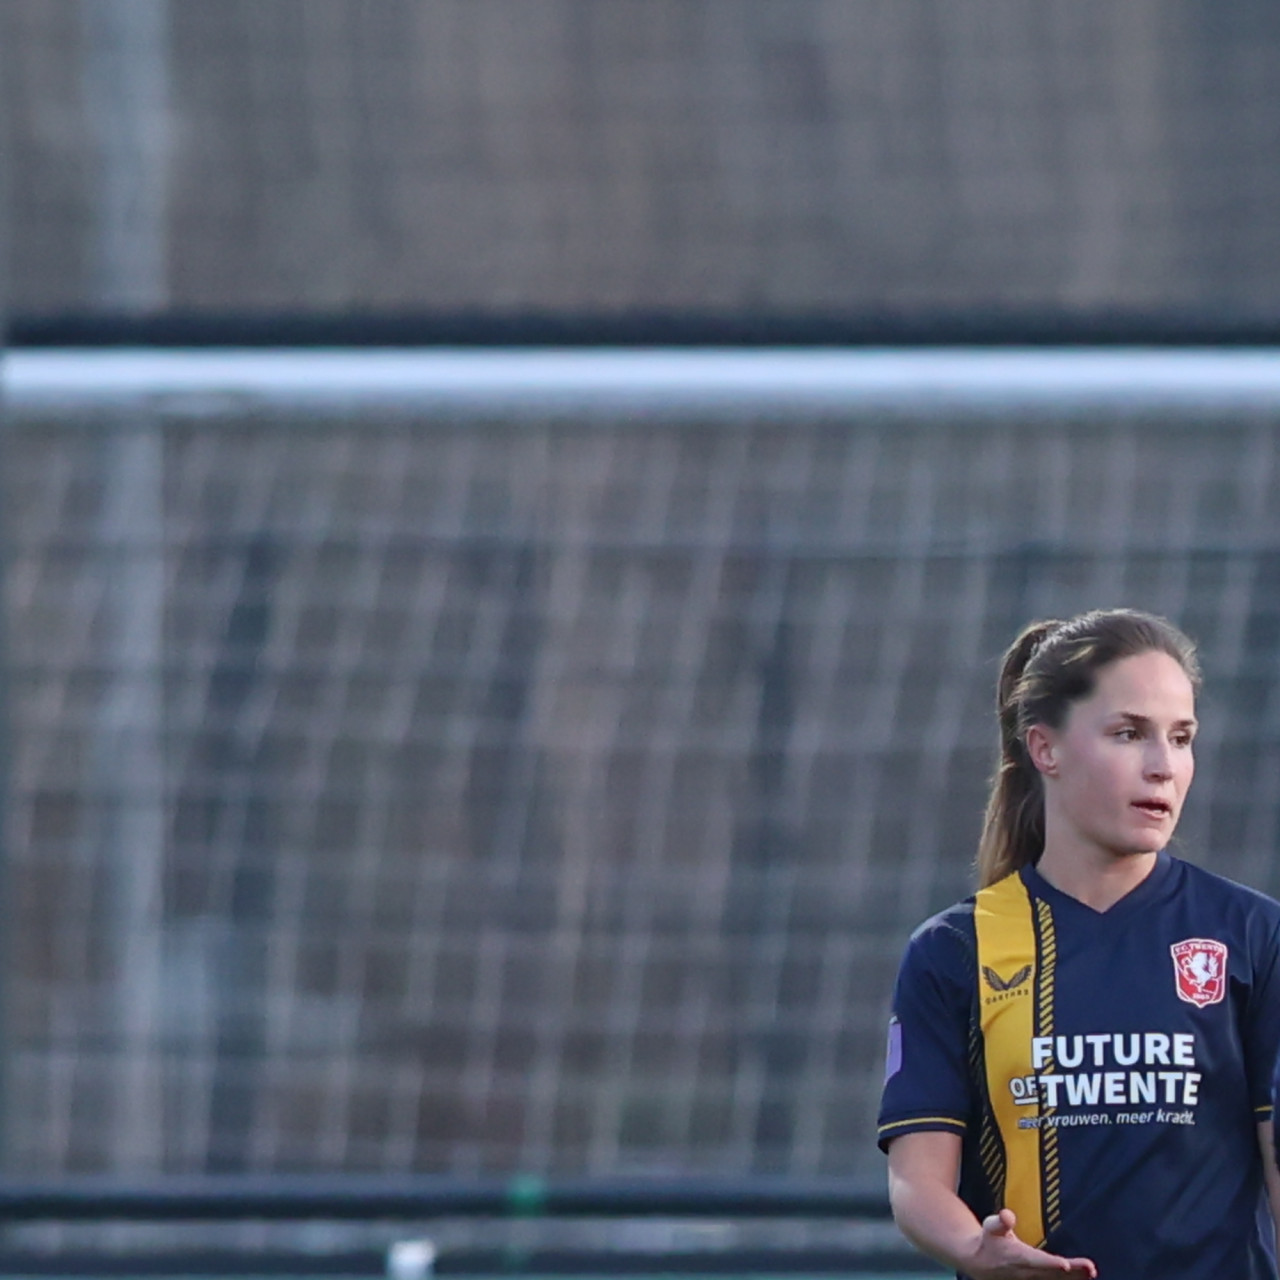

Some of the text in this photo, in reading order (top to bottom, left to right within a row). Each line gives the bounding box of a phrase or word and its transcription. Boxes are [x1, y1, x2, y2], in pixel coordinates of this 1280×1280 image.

[1032, 1033, 1195, 1069] FUTURE
[1010, 1072, 1202, 1107] OF TWENTE
[1116, 1111, 1152, 1125] meer
